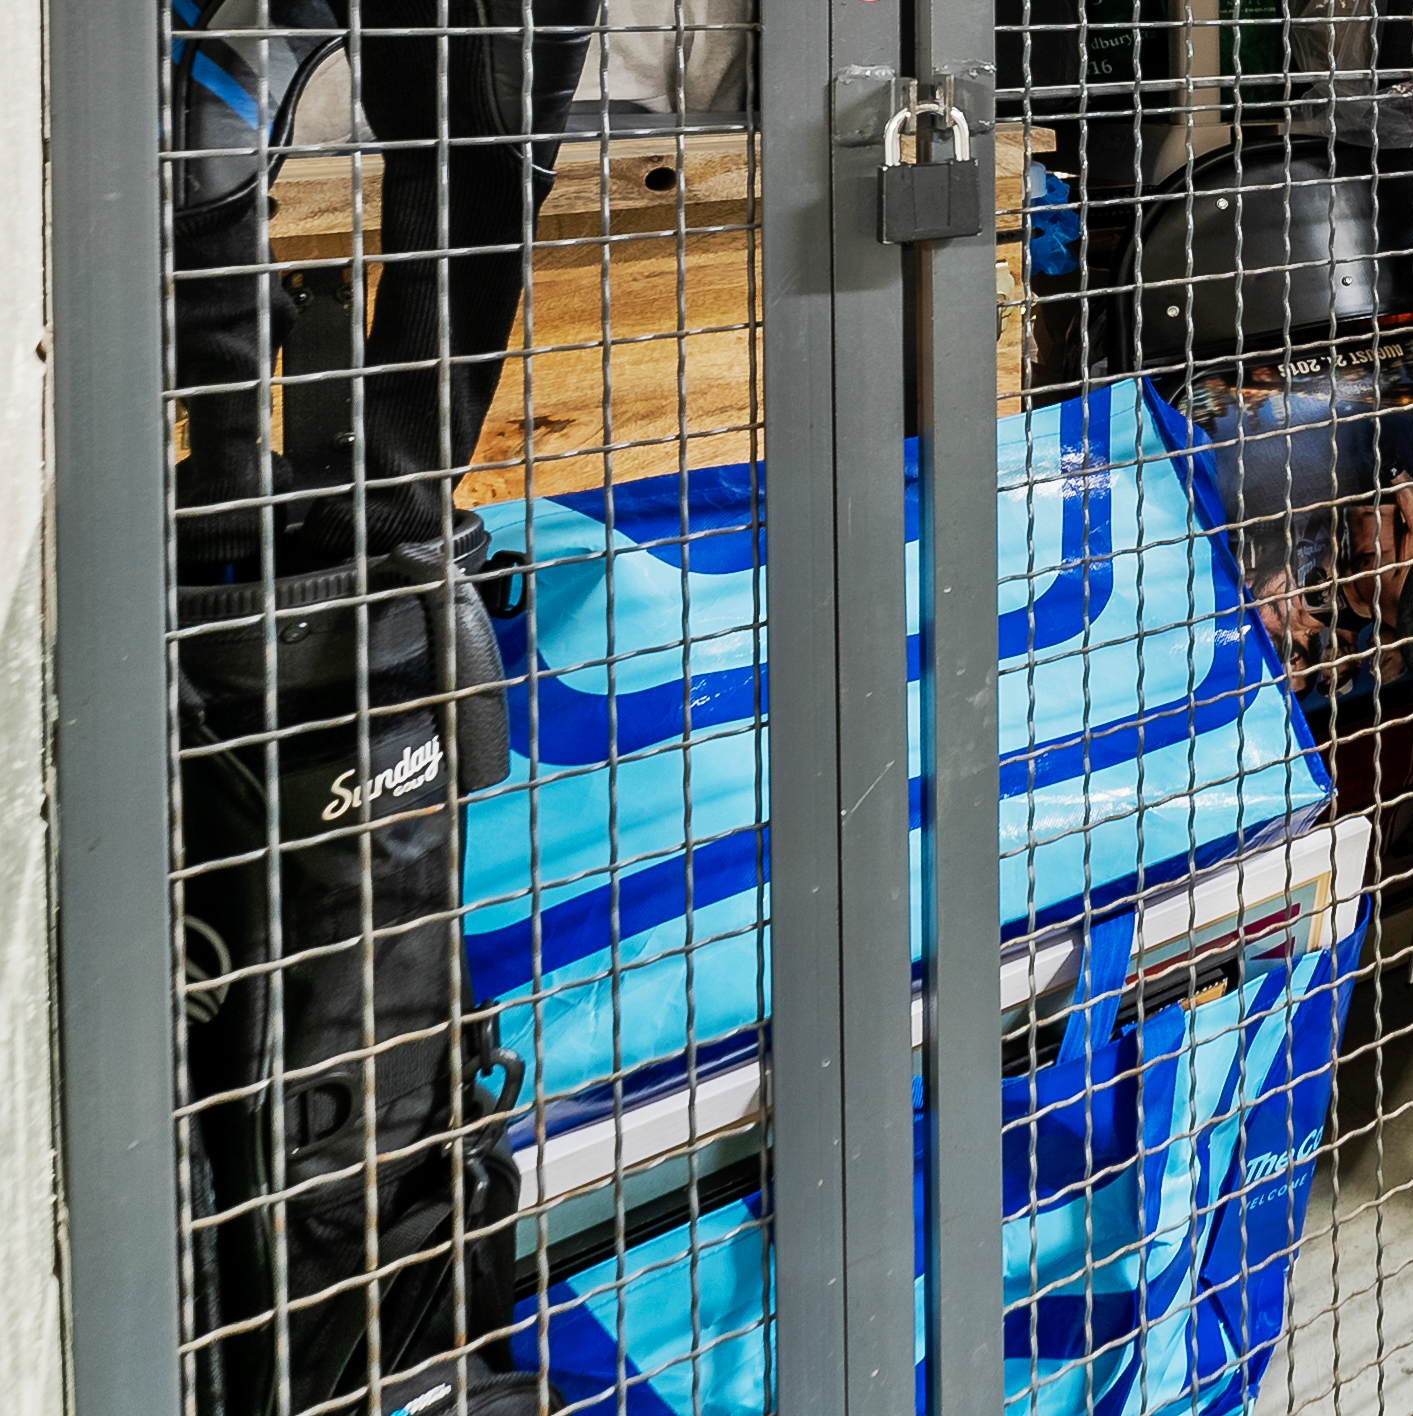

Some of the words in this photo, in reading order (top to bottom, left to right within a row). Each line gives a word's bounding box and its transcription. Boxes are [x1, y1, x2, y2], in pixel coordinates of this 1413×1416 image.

[1348, 343, 1404, 365] AUGUST
[321, 734, 444, 821] Sunday
[1245, 1148, 1296, 1186] The
